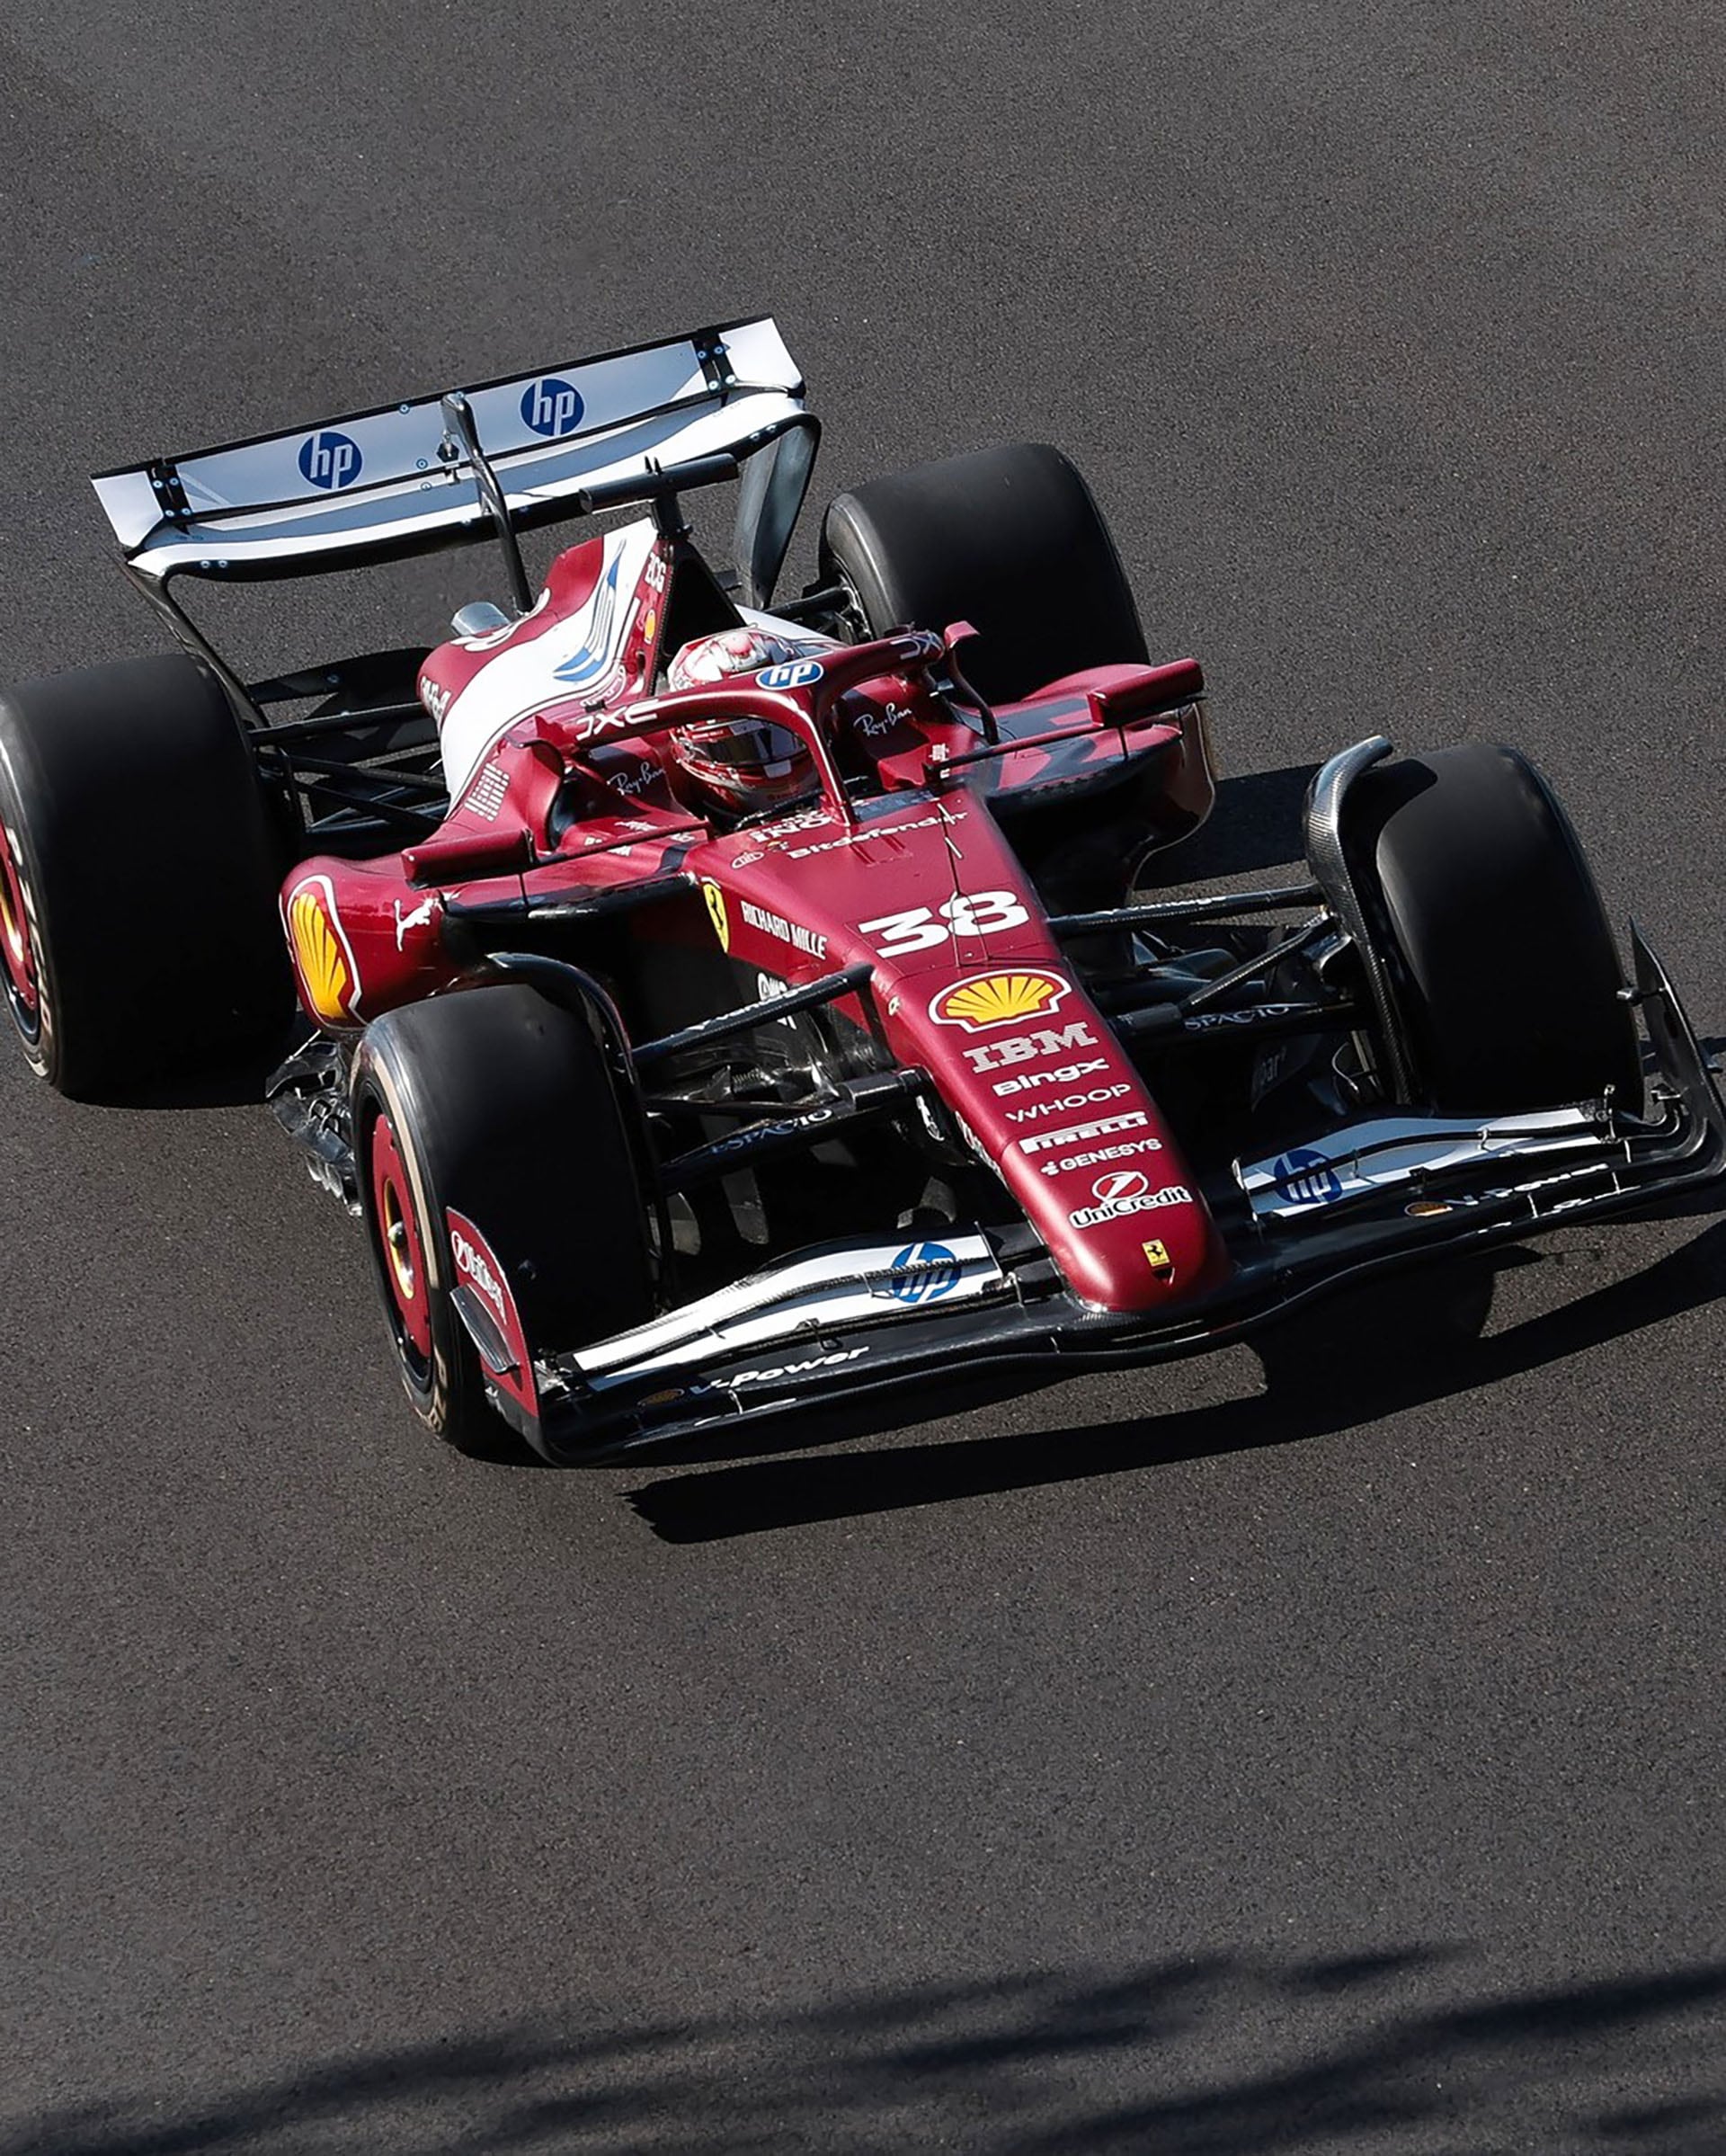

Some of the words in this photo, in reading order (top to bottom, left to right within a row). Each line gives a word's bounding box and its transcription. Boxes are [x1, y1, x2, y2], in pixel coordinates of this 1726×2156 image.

[531, 377, 575, 438] hp
[309, 431, 353, 491] hp
[889, 631, 943, 661] DX
[853, 702, 912, 736] Ray-Ban
[740, 900, 790, 943] RICHARD
[790, 922, 828, 960] MILLE
[859, 890, 1031, 959] 38
[962, 1021, 1099, 1074] IBM
[1005, 1083, 1132, 1123] WHOOP
[1019, 1111, 1149, 1154] PIRELLI
[1059, 1138, 1162, 1172] GENESYS
[1280, 1152, 1332, 1204] hp
[1071, 1186, 1191, 1227] UniCredit
[899, 1243, 955, 1303] hp
[689, 1346, 870, 1395] V-Power
